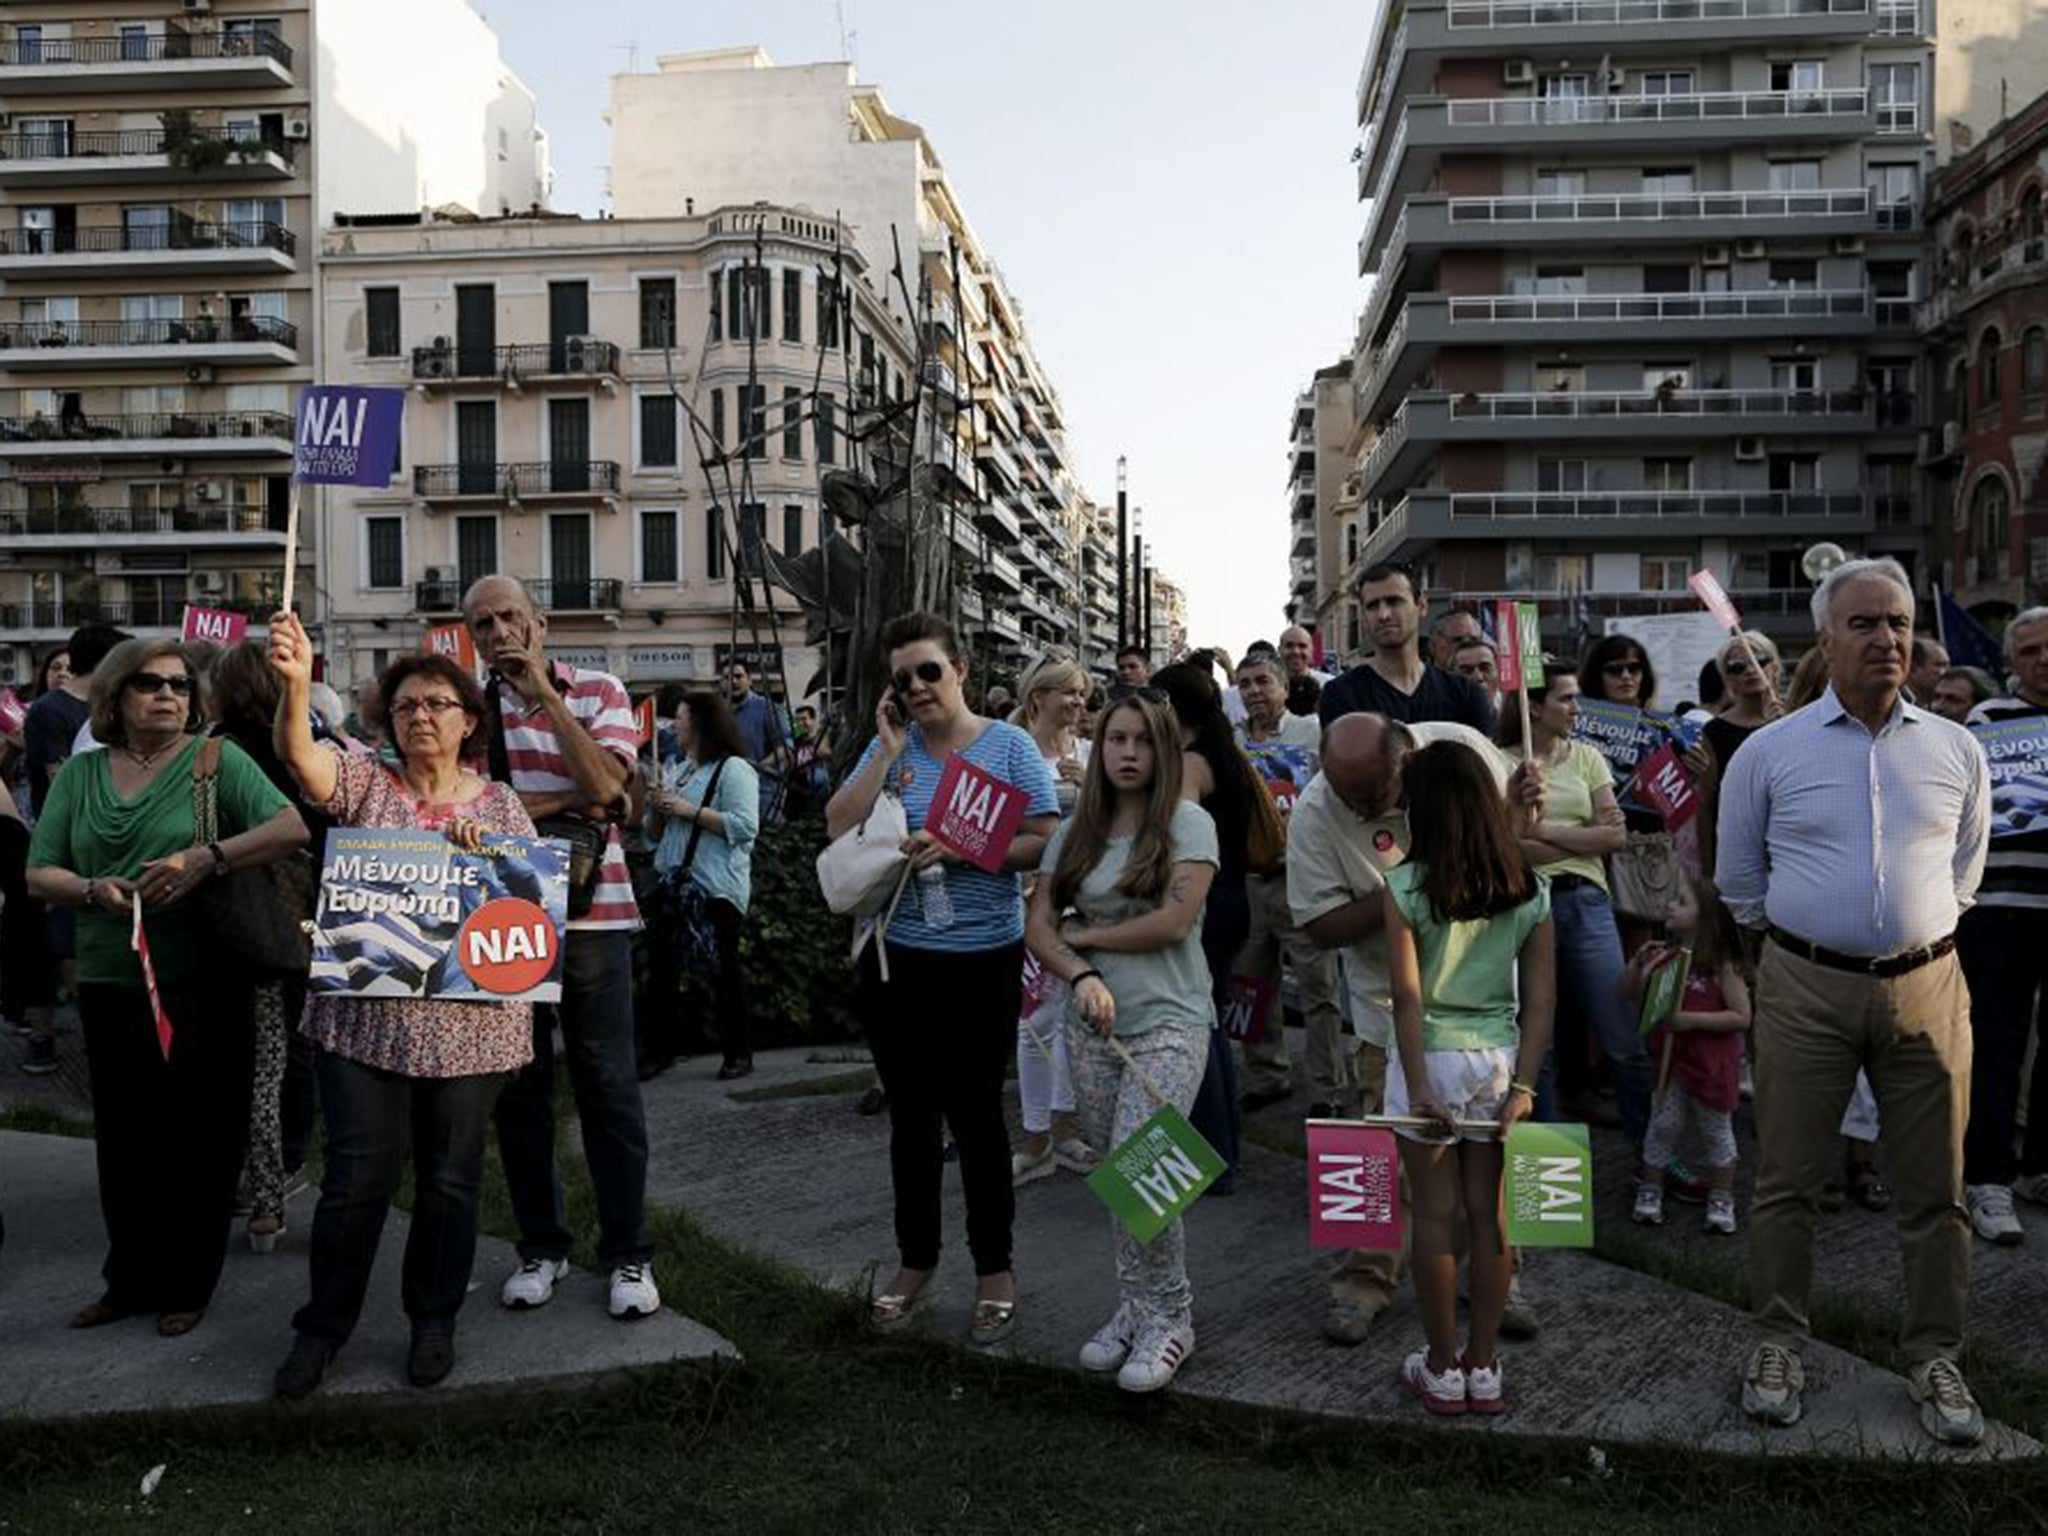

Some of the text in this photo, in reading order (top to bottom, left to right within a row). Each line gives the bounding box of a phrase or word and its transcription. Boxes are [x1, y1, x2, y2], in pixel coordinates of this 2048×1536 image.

[301, 396, 368, 447] ΝΑΙ
[196, 612, 231, 639] ΝΑΙ
[432, 628, 460, 656] ΝΑΙ
[949, 769, 1008, 834] ΝΑΙ
[1656, 760, 1693, 809] ΝΑΙ
[331, 855, 480, 889] Μένουμε
[328, 884, 460, 923] Ευρώπη
[470, 923, 548, 966] ΝΑΙ
[1131, 1145, 1204, 1217] ΝΑΙ
[1319, 1154, 1366, 1220] ΝΑΙ
[1539, 1156, 1583, 1221] ΝΑΙ
